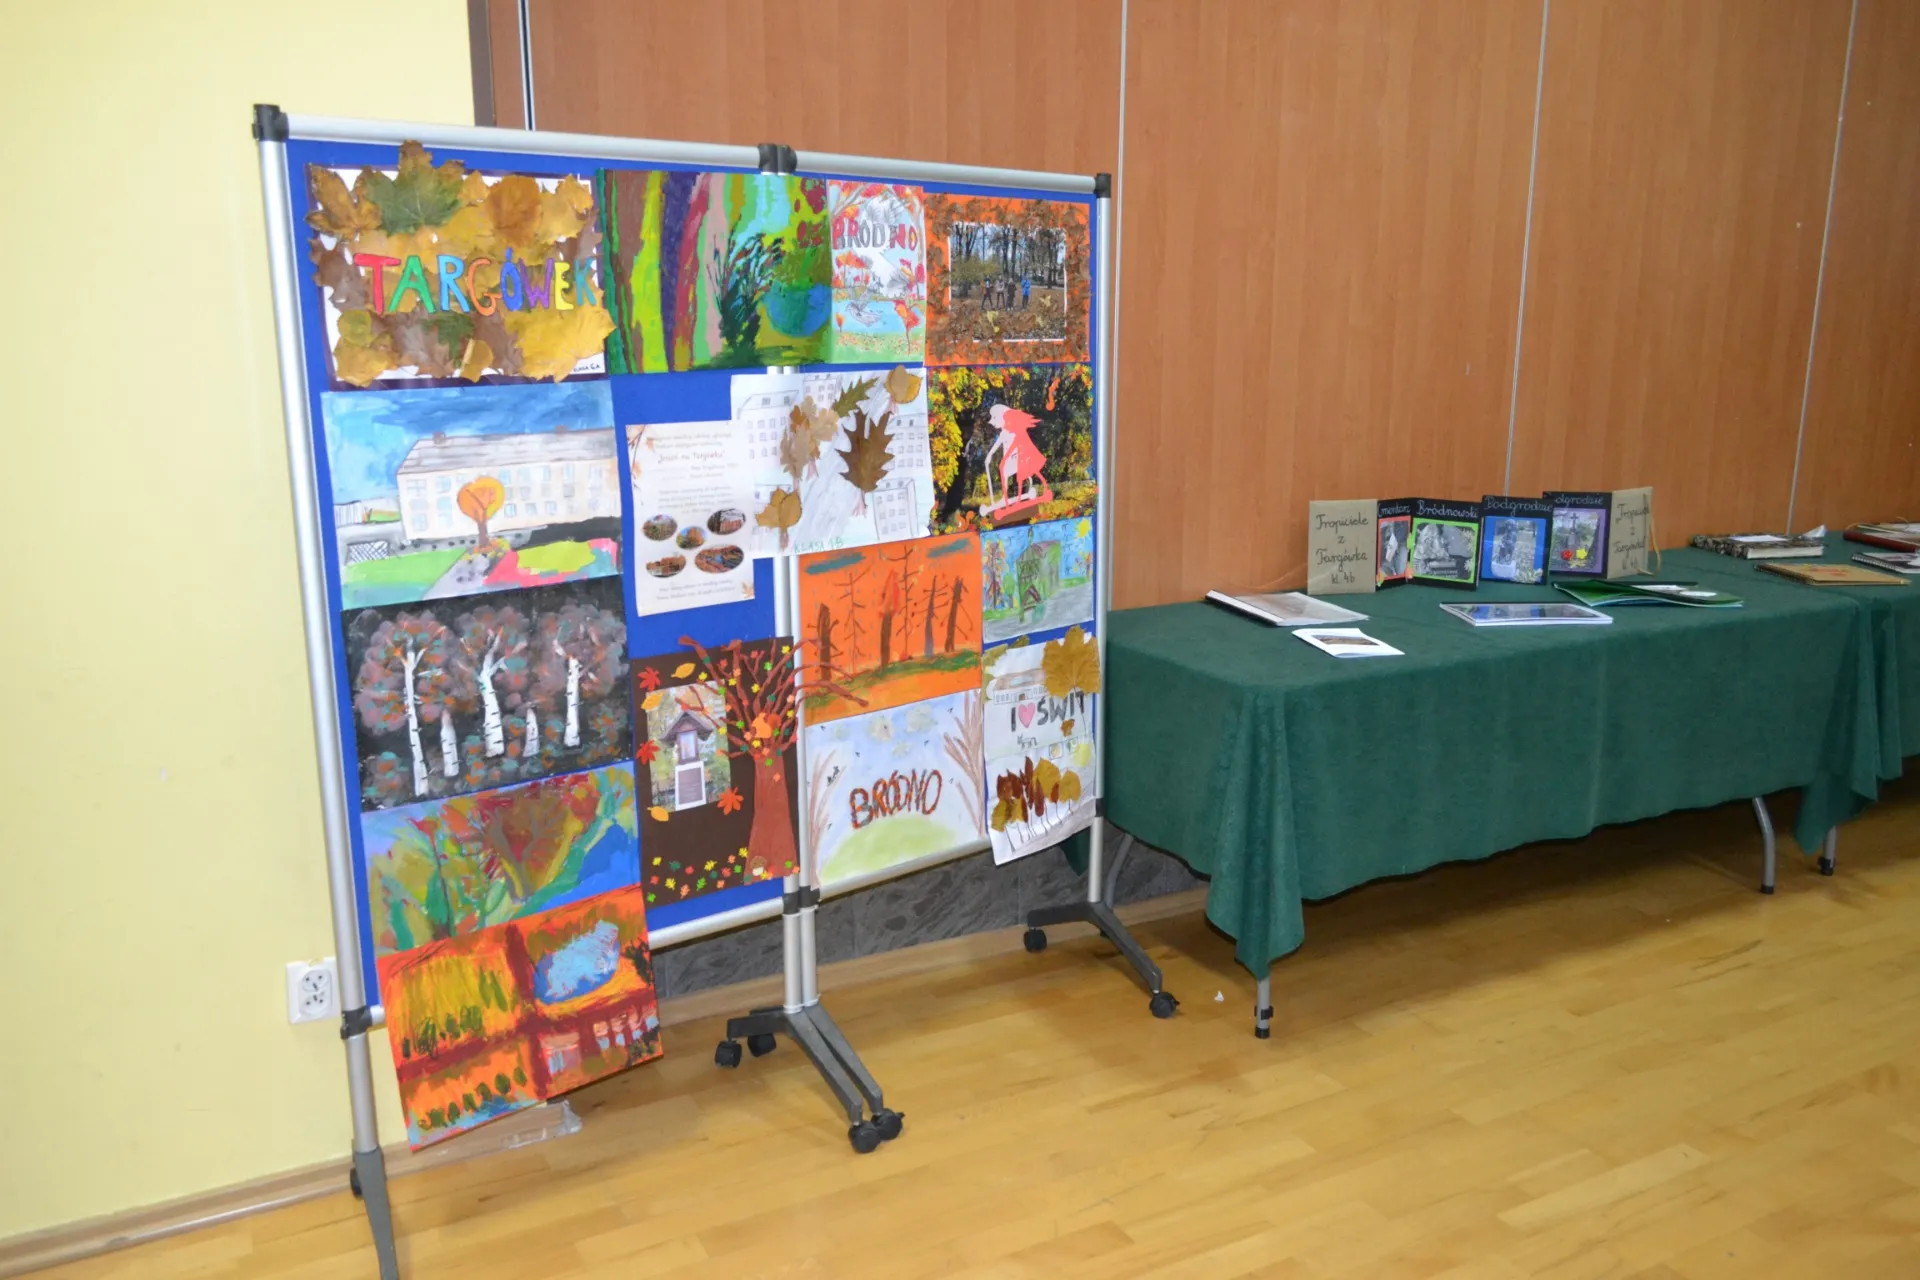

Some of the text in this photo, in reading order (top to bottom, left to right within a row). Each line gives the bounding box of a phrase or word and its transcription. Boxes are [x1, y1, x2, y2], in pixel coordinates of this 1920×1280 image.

[353, 247, 598, 317] TARGÓWEK
[1416, 499, 1479, 519] Bródnowski
[1484, 495, 1554, 518] Podgrodzie
[1315, 511, 1369, 534] Tropiciele
[1337, 535, 1345, 545] z
[1315, 546, 1368, 573] Targówka
[1343, 572, 1356, 584] 4b
[1010, 706, 1017, 733] I
